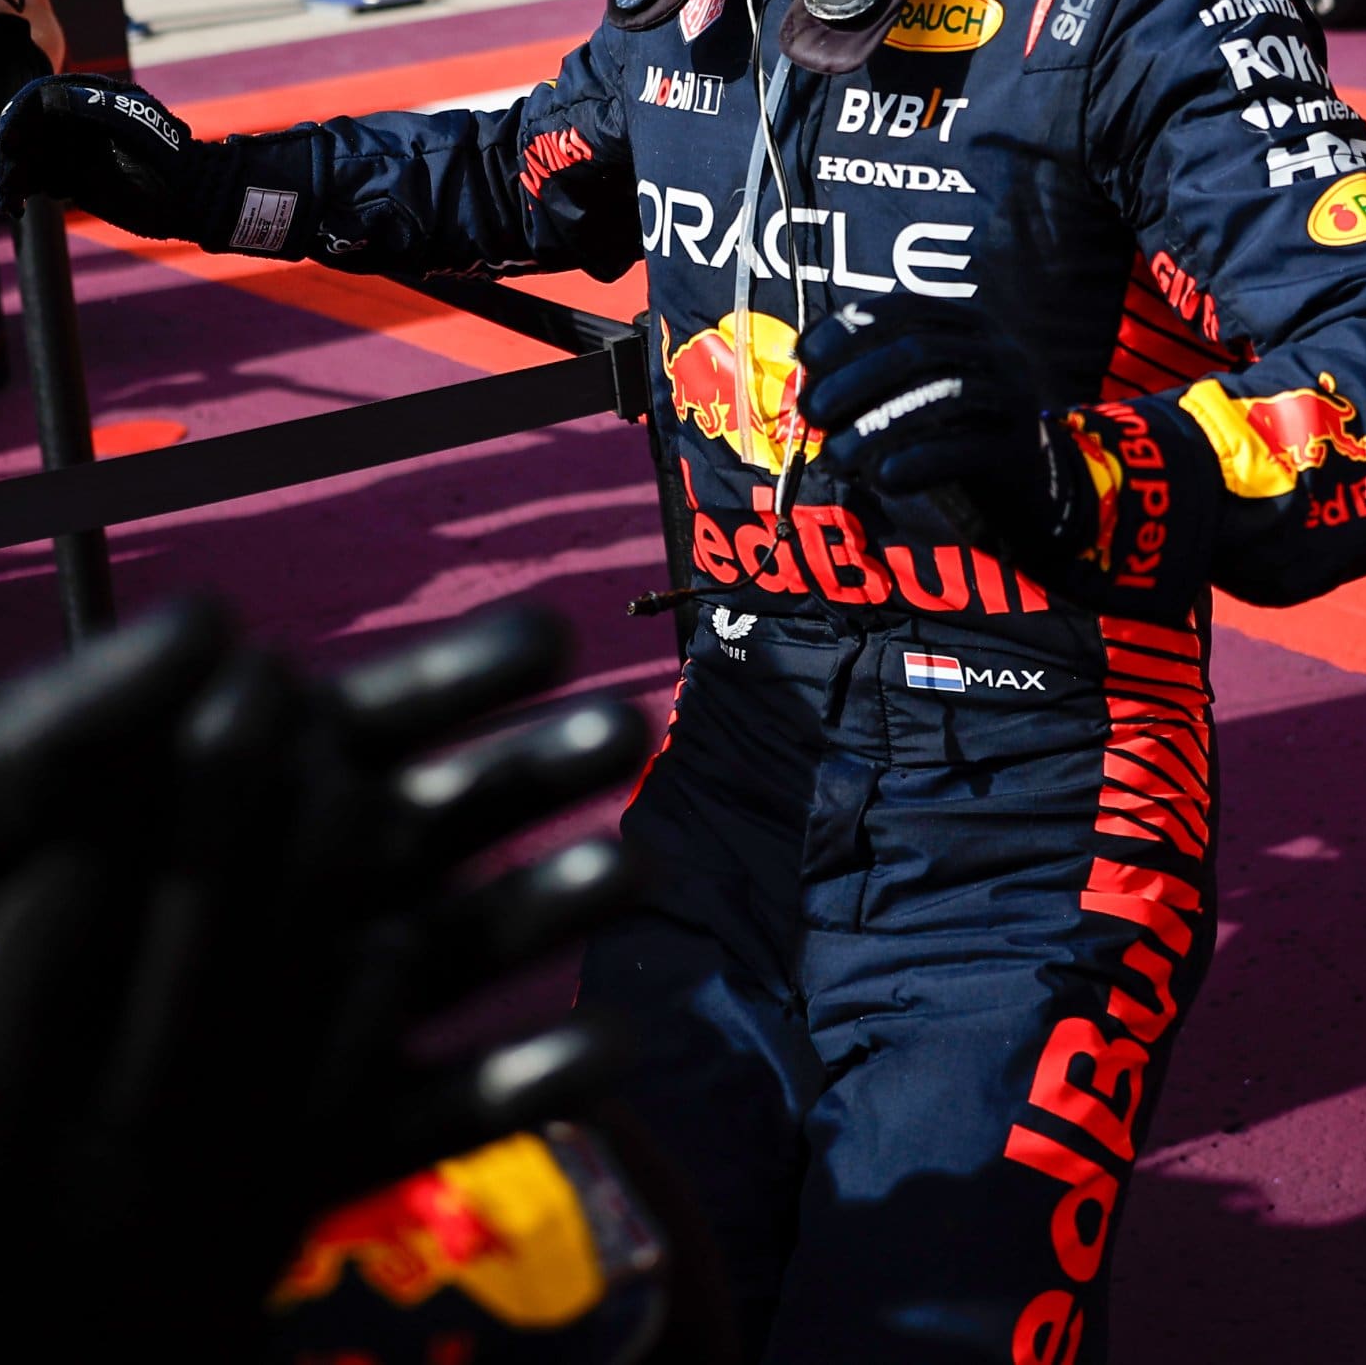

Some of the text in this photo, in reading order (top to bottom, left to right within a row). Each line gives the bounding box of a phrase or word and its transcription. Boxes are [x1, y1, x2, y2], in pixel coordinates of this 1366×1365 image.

[893, 5, 986, 36] RAUCH
[639, 65, 697, 109] Mobil
[1219, 35, 1331, 91] ROK
[114, 94, 181, 151] sparco
[837, 87, 969, 143] BYBIT
[817, 155, 977, 194] HONDA
[637, 178, 979, 298] ORACLE
[964, 667, 1047, 692] MAX
